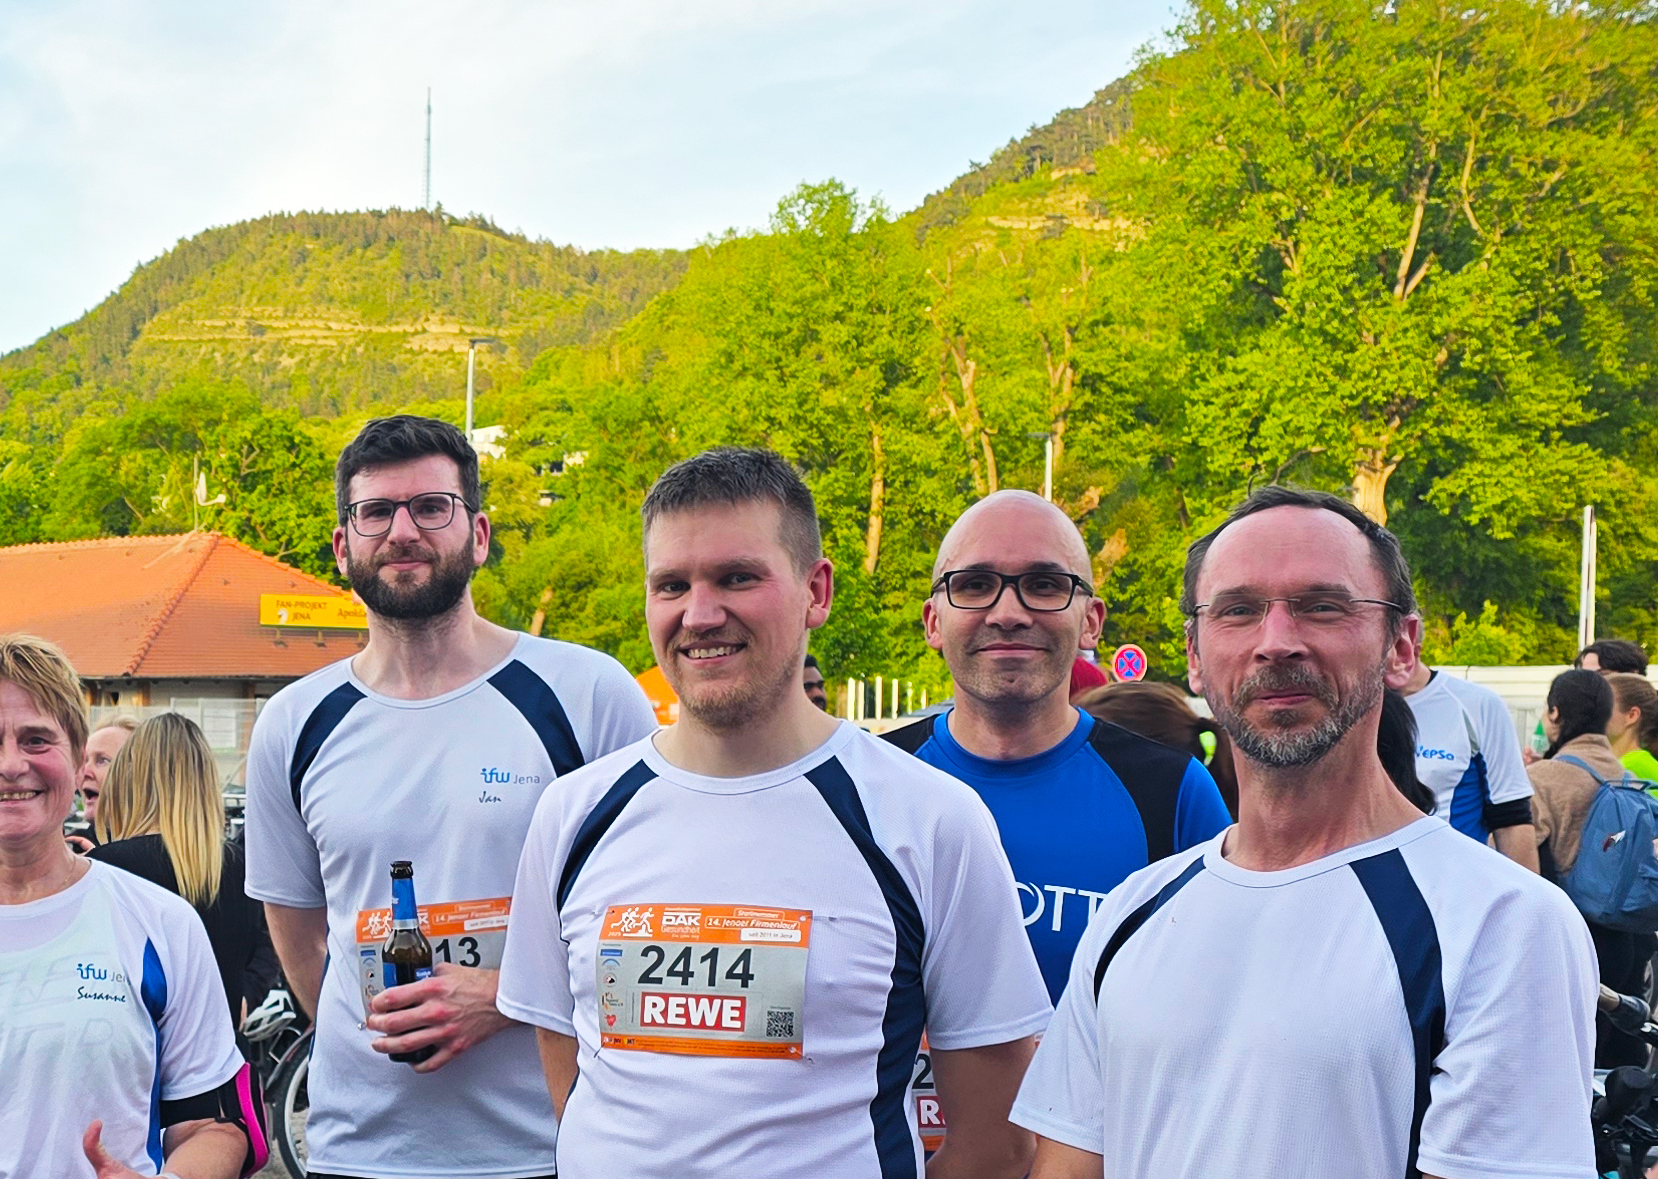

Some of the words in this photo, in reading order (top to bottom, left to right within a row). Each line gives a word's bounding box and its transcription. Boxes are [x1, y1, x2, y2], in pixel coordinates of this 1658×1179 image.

[480, 767, 510, 784] ifw
[513, 774, 541, 785] Jena
[479, 790, 502, 804] Jan
[662, 915, 700, 926] DAK
[707, 917, 720, 926] 14.
[436, 936, 481, 968] 13
[76, 963, 107, 980] ifw
[637, 944, 754, 988] 2414
[77, 986, 126, 1002] Susanne
[643, 995, 742, 1029] REWE
[919, 1099, 946, 1125] R
